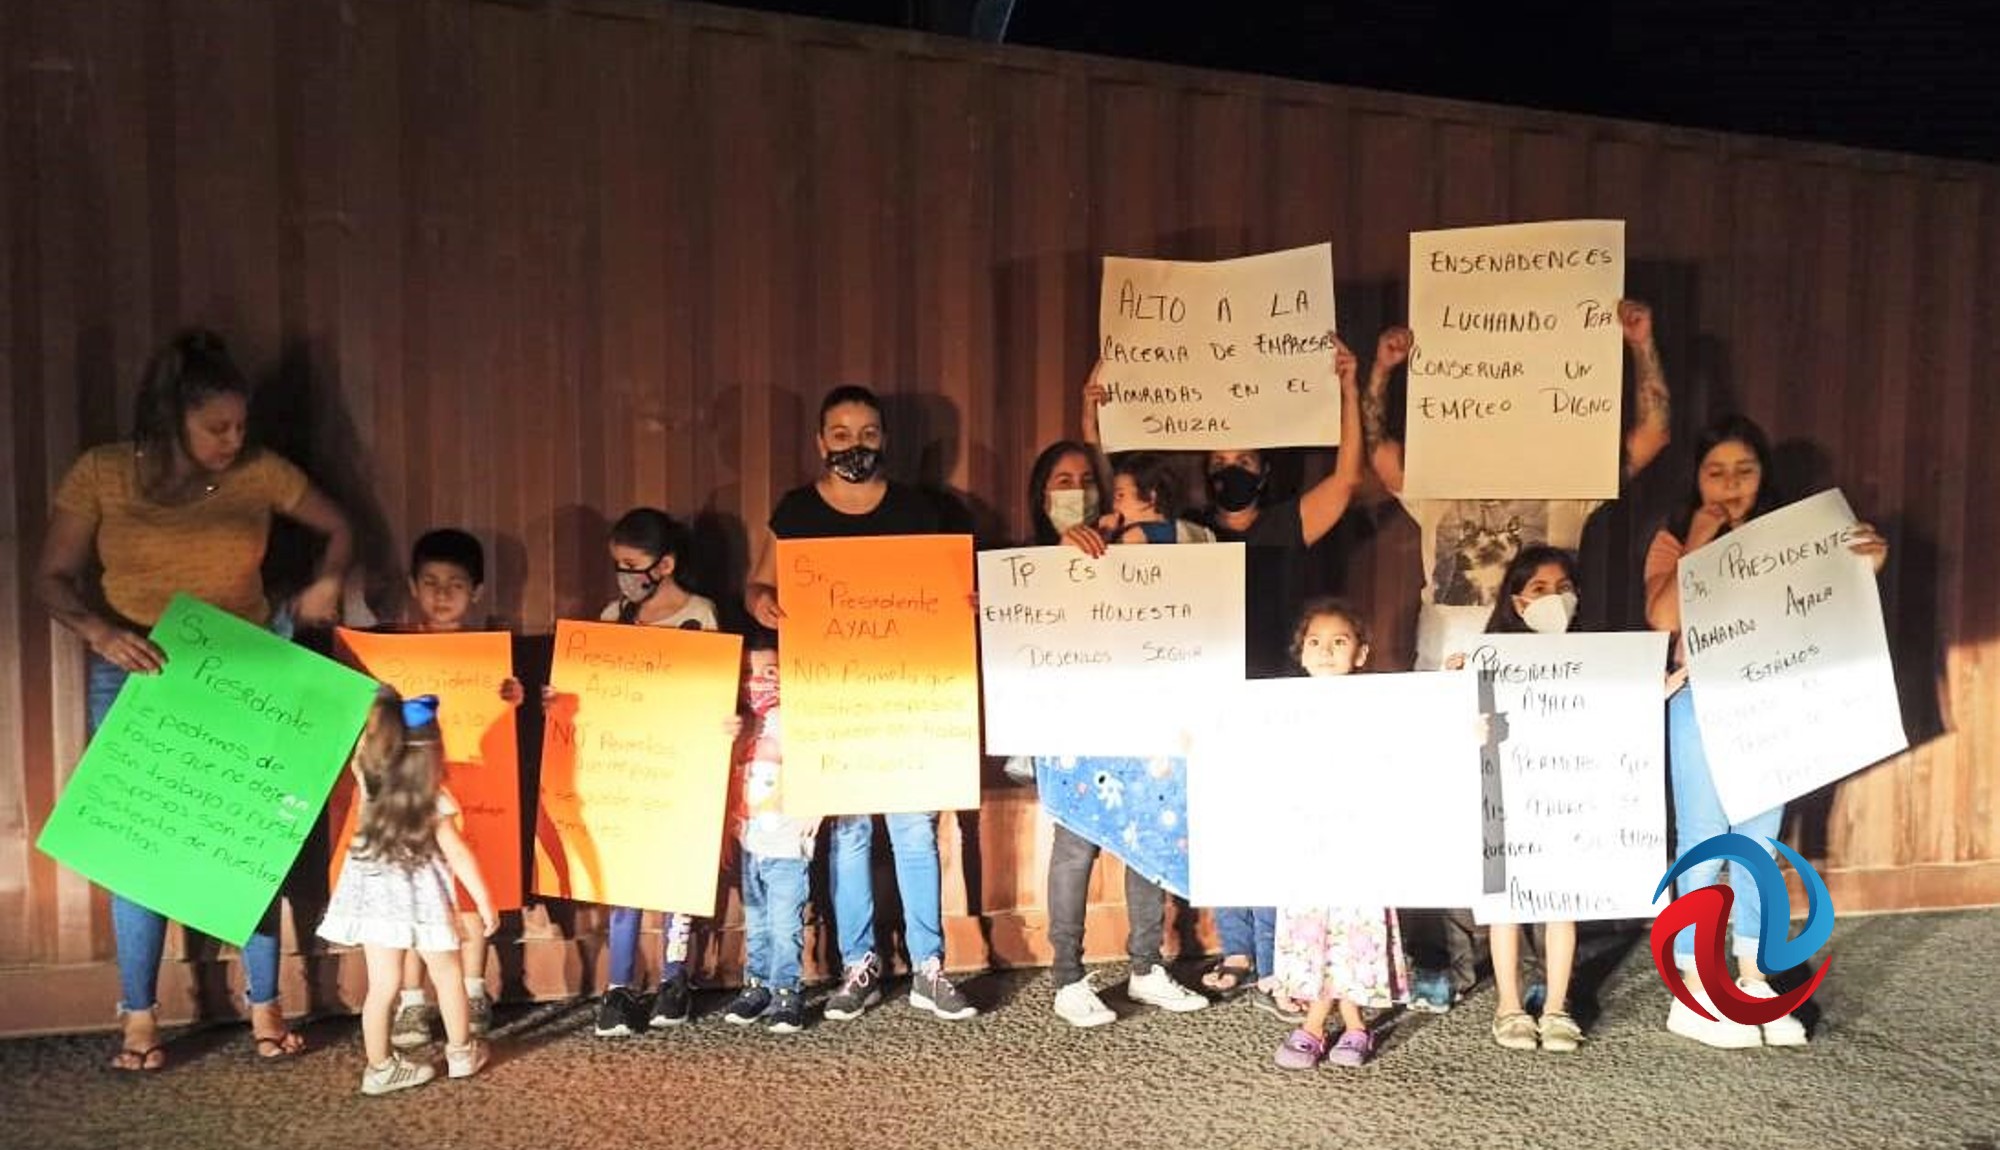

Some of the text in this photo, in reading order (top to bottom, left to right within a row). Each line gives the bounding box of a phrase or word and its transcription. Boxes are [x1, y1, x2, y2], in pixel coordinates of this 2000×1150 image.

[1431, 248, 1613, 274] ENSENADENCES
[1119, 278, 1310, 324] ALTO A LA
[1442, 299, 1613, 334] LUCHANDO POR
[1103, 332, 1336, 365] CACERIA DE EMPRESAS
[1408, 343, 1593, 380] CONSERVAR UN
[1106, 378, 1312, 405] HONRADAS EN EL
[1420, 386, 1613, 420] EMPLEO DIGNO
[1718, 531, 1851, 581] PRESIDENTE
[1121, 562, 1163, 587] UNA
[985, 602, 1193, 626] EMPRESA HONESTA
[1786, 584, 1833, 618] AYALA
[824, 617, 899, 641] AYALA
[1472, 644, 1584, 685] PRESIDENTE
[256, 755, 285, 774] de
